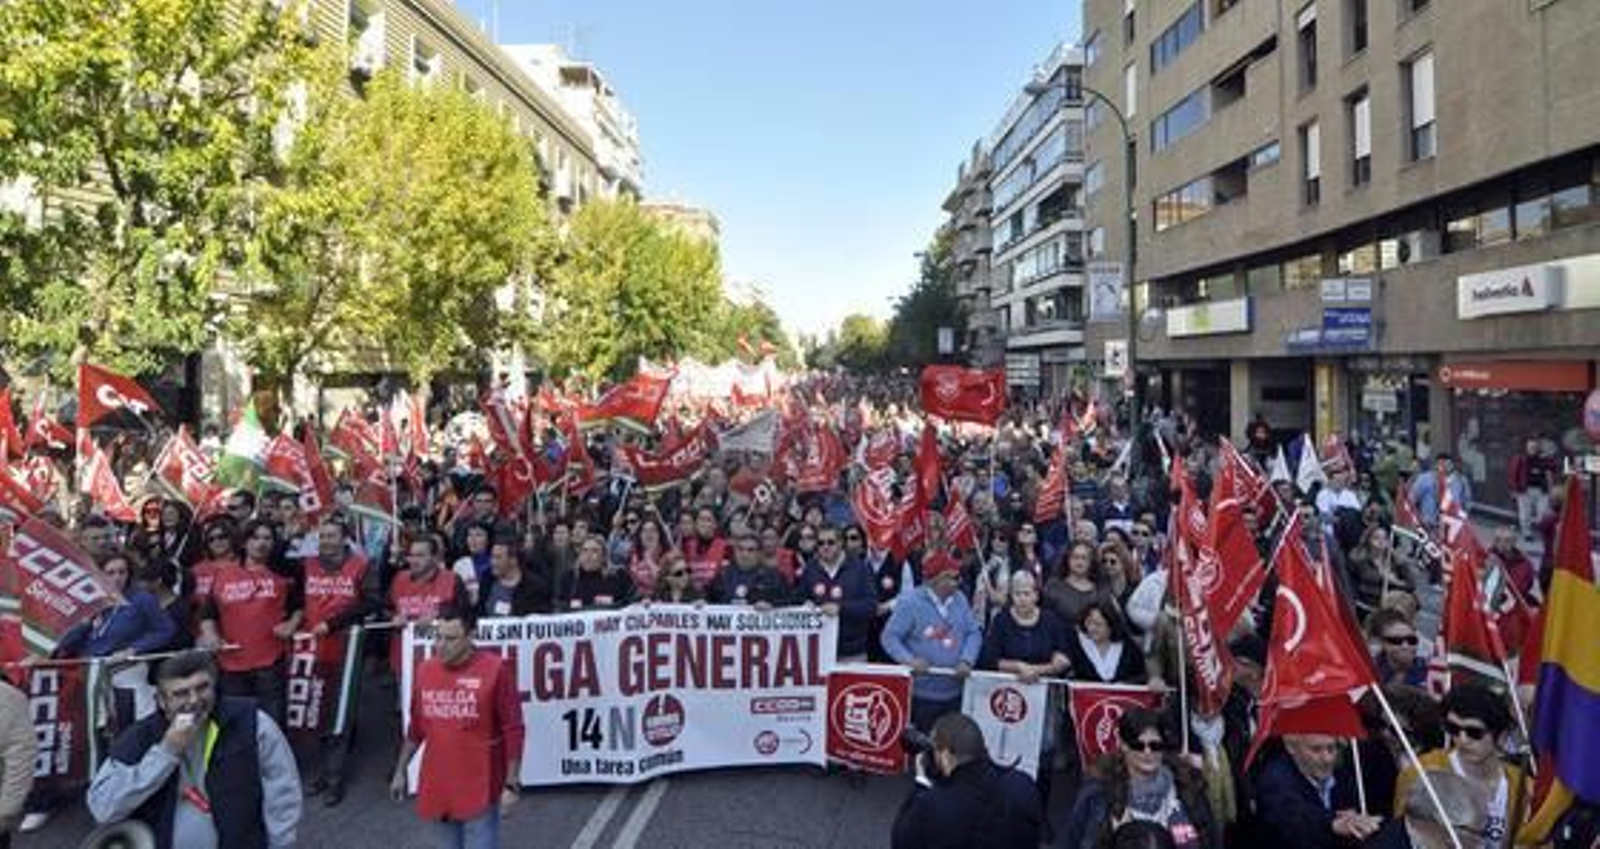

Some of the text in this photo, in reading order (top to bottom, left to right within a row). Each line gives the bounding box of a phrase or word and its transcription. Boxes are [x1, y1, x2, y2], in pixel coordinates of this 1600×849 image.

[1472, 282, 1518, 301] helvetia
[497, 622, 524, 640] SIN
[527, 618, 586, 640] FUTURO
[593, 615, 622, 633] HAY
[624, 612, 700, 632] CULPABLES
[707, 614, 733, 630] HAY
[736, 612, 823, 630] SOLUCIONES
[618, 631, 829, 698] GENERAL
[561, 757, 592, 776] Una
[595, 756, 635, 777] tarea
